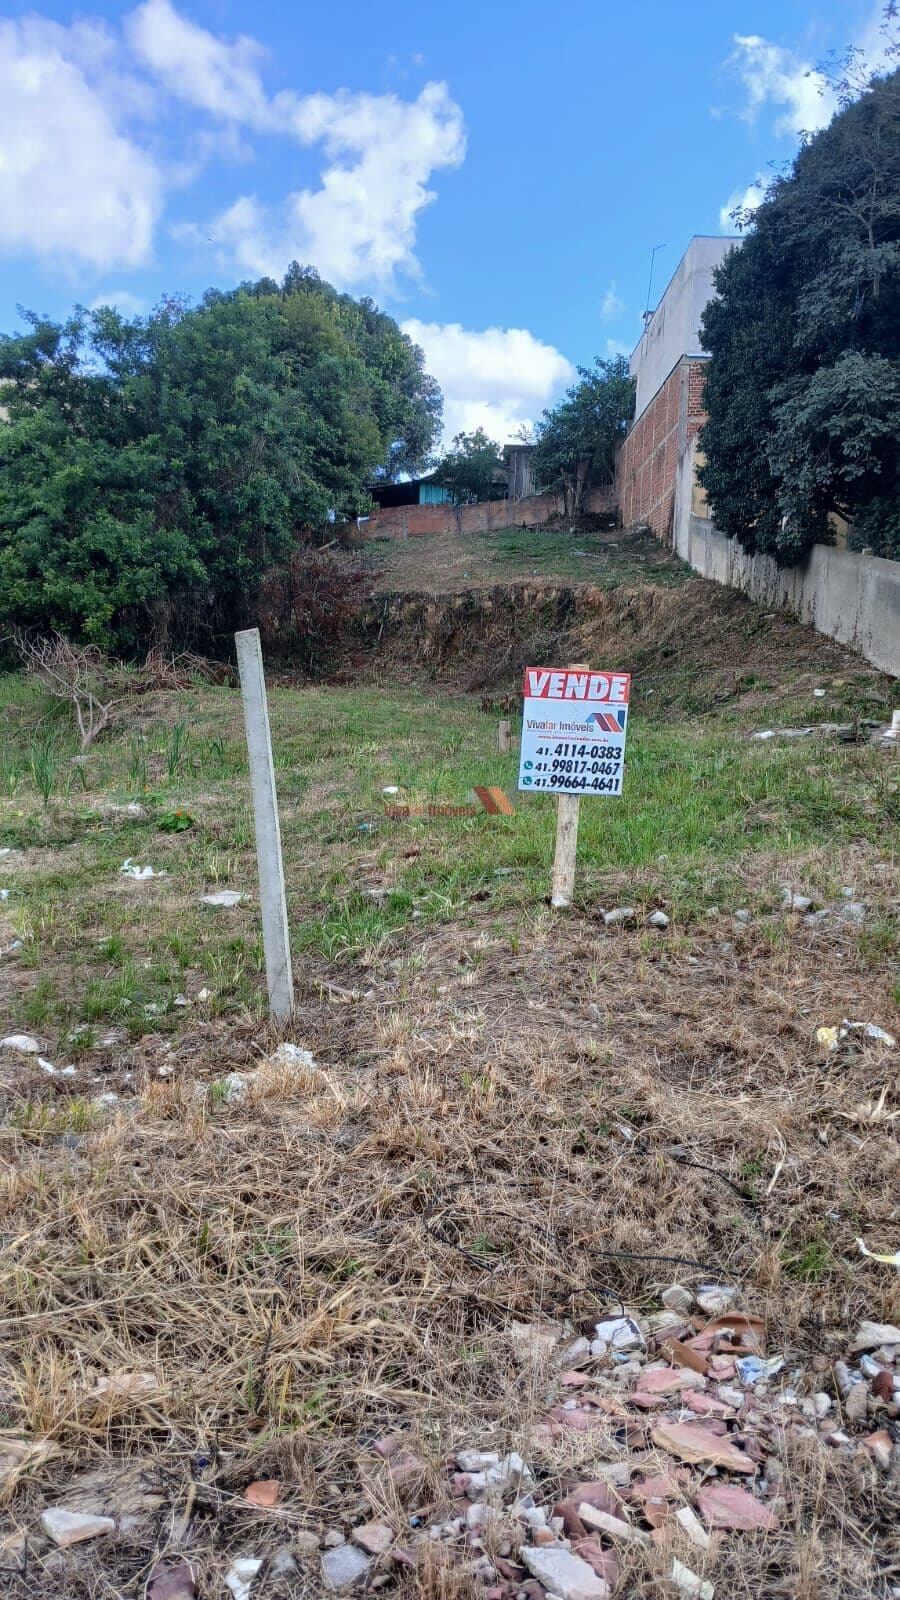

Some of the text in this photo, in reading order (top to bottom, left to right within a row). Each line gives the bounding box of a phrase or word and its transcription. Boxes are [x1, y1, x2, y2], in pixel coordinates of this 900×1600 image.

[527, 671, 628, 704] VENDE
[526, 720, 557, 731] Vivalar
[559, 721, 595, 733] Imóveis
[536, 743, 622, 760] 41.4114-0383
[535, 759, 621, 776] 41.99817-0467
[533, 774, 620, 792] 41.99664-4641
